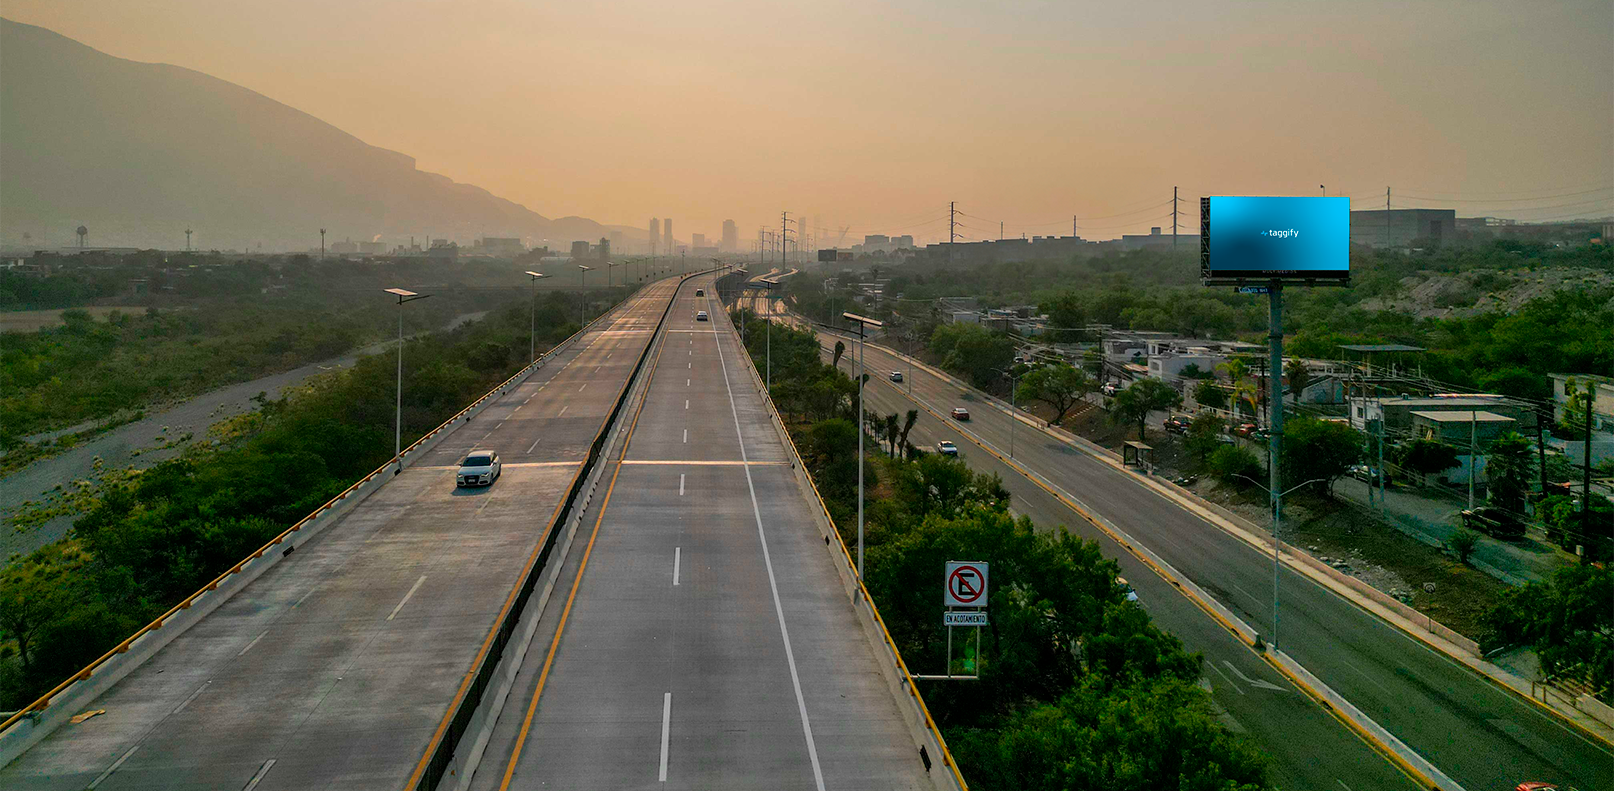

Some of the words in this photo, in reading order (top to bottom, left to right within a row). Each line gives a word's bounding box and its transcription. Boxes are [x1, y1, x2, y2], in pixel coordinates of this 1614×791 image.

[1269, 228, 1299, 238] taggify
[958, 572, 975, 595] E
[946, 615, 953, 623] EN
[954, 615, 986, 623] ACOTAMIENTO
